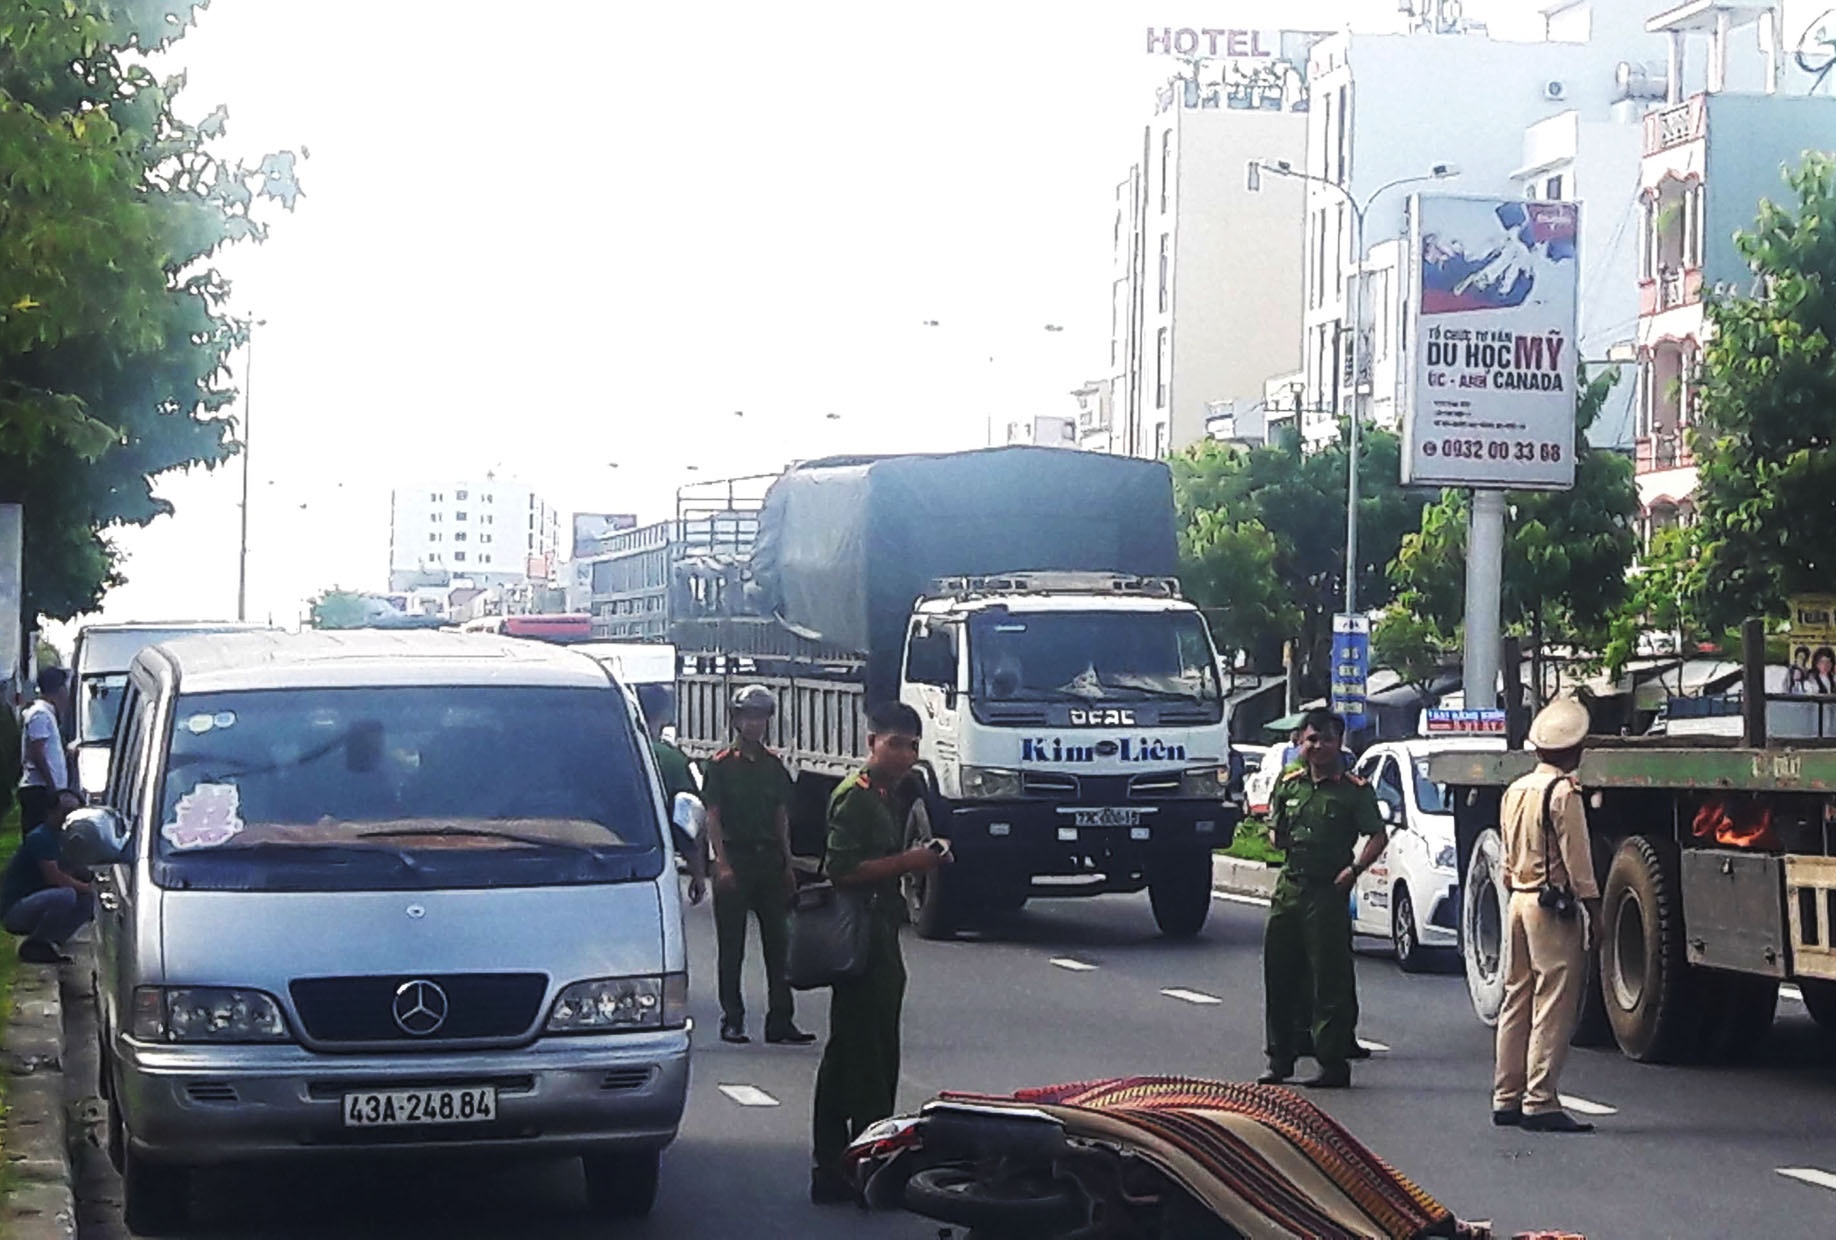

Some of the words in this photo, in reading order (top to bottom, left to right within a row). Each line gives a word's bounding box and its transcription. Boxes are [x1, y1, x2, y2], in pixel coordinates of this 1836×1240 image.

[1146, 26, 1271, 57] HOTEL
[1427, 341, 1458, 367] DU
[1465, 342, 1511, 374] HỌC
[1514, 329, 1564, 371] MỸ
[1493, 371, 1564, 392] CANADA
[1514, 441, 1535, 461] 33
[1021, 737, 1094, 762] Kim
[1119, 736, 1186, 762] Liên
[349, 1090, 491, 1122] 43A-248.84
